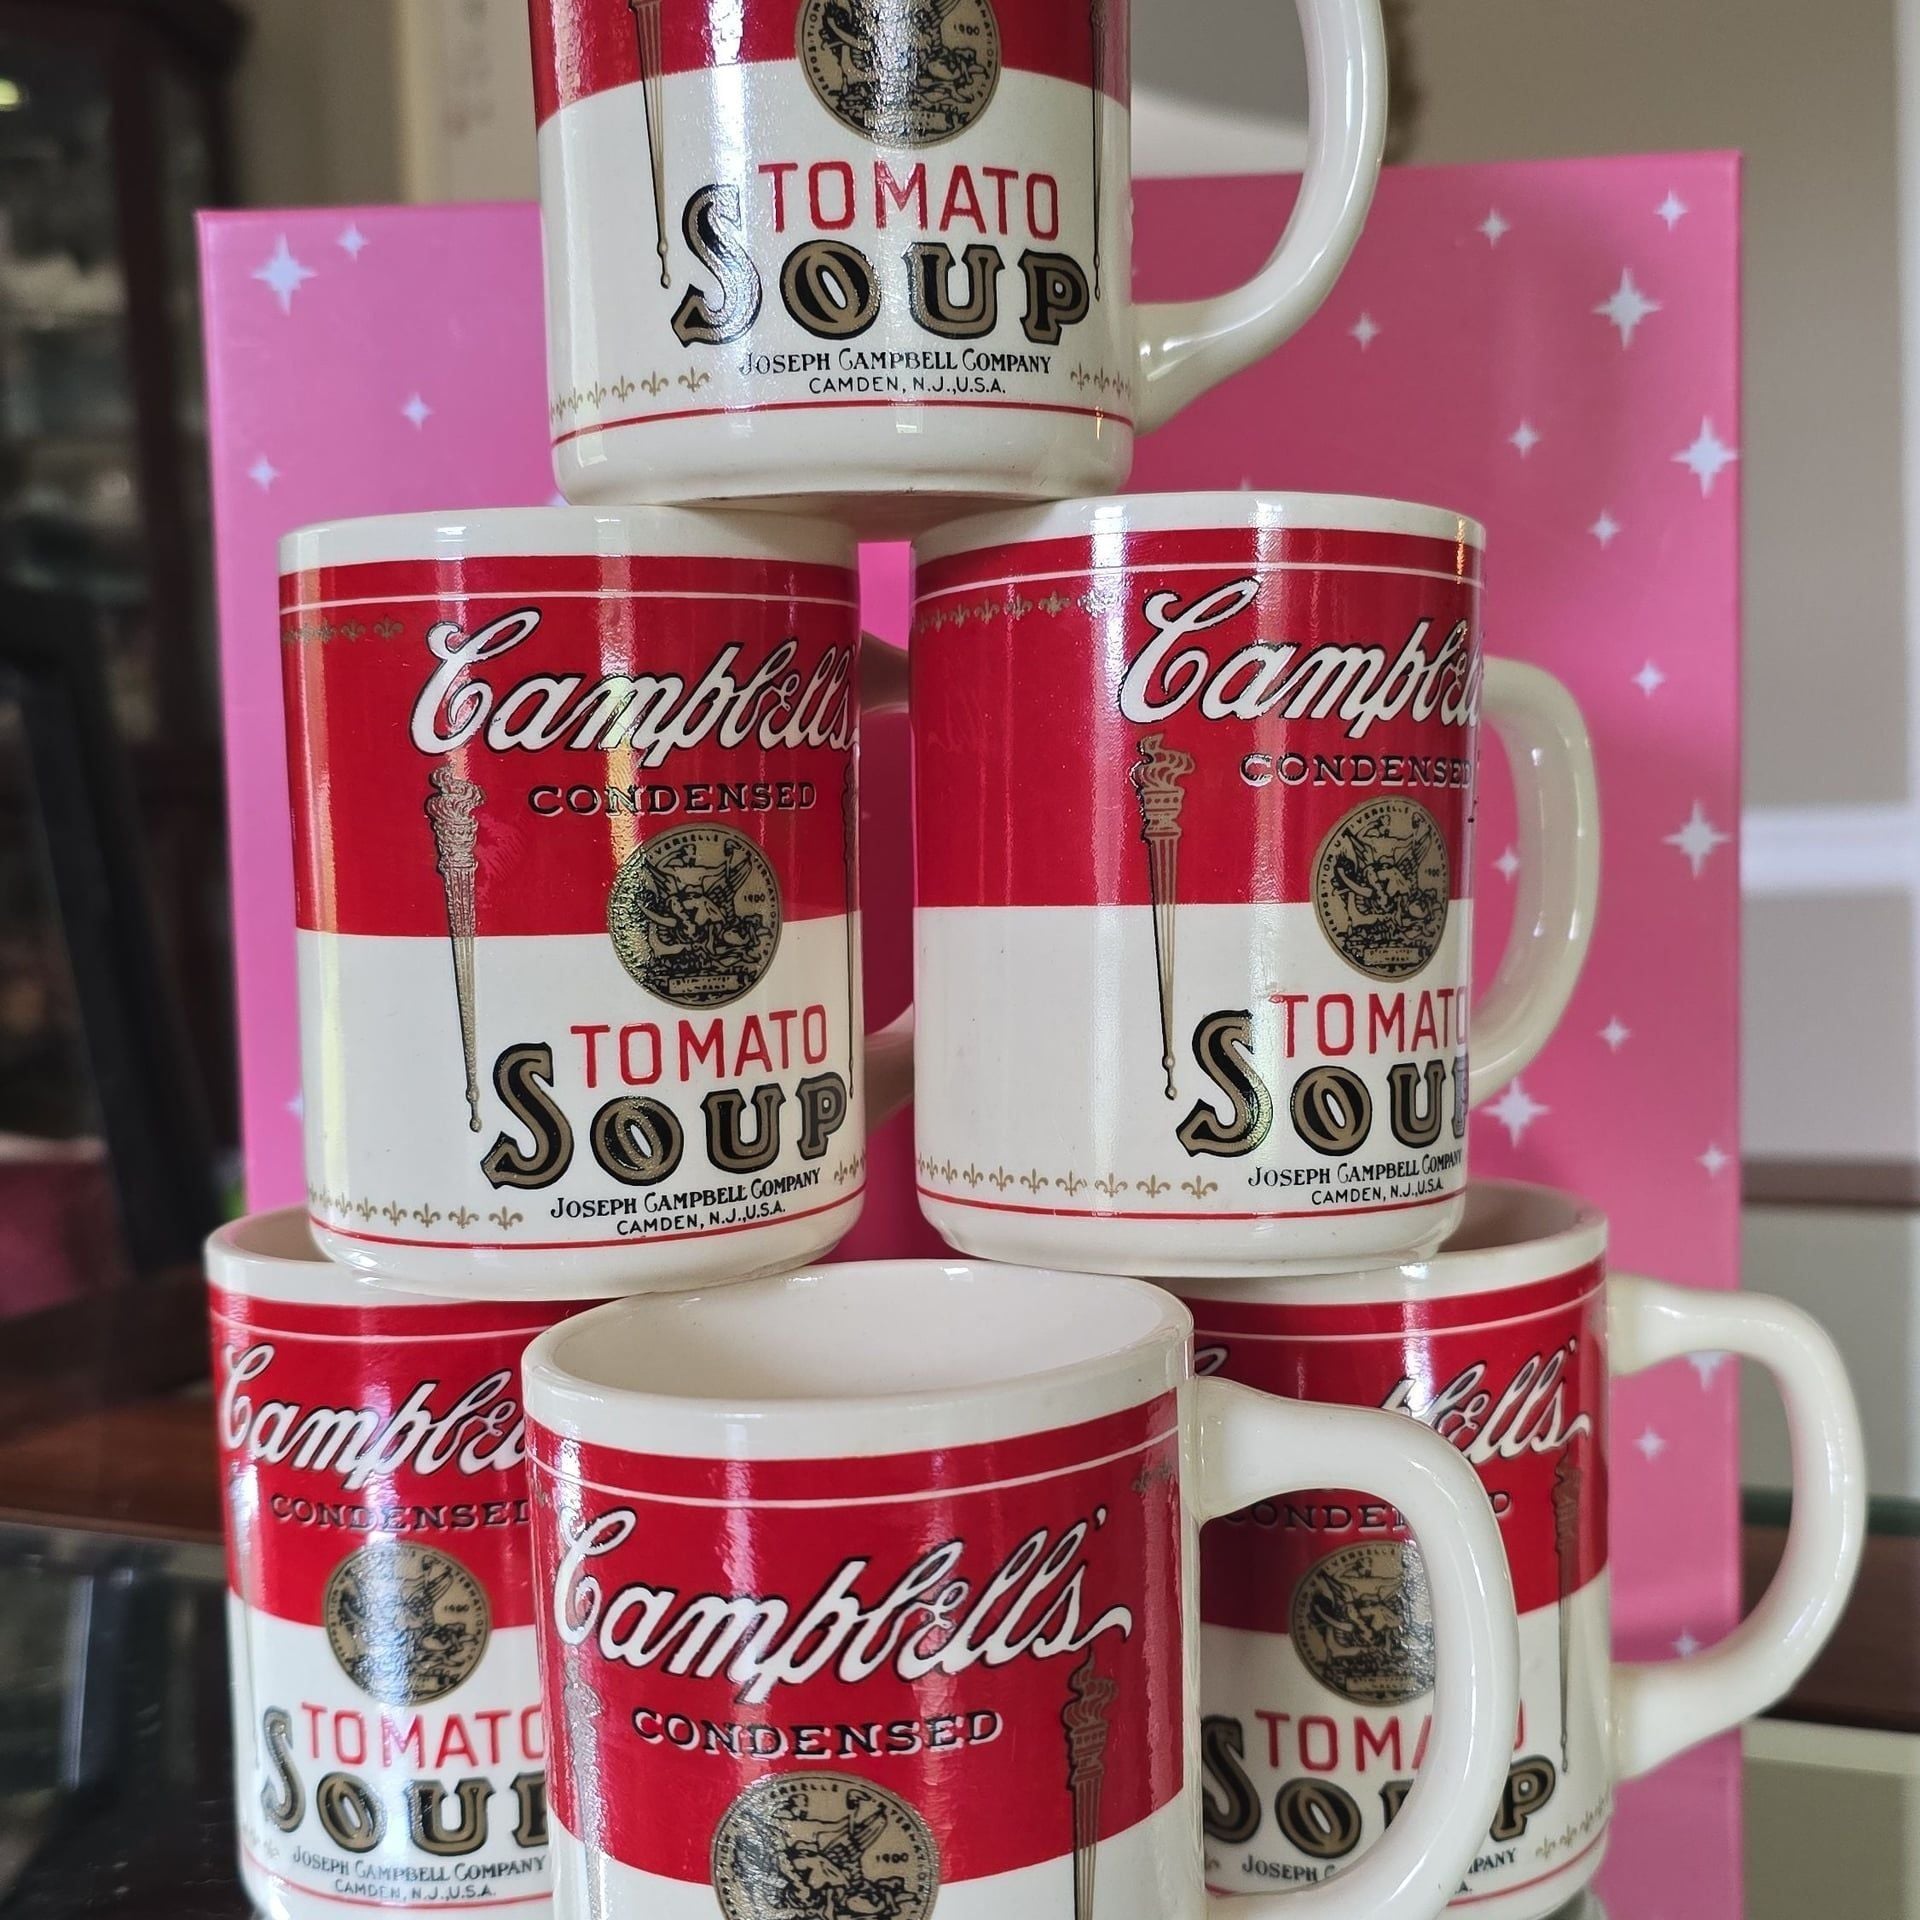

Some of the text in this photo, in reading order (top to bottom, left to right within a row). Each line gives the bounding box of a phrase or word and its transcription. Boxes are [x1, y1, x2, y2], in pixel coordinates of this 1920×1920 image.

[758, 161, 1059, 240] TOMATO
[671, 184, 1089, 346] SOUP
[739, 347, 1051, 376] JOSEPH CAMPBELL COMPANY
[809, 376, 907, 395] CAMDEN,
[1240, 752, 1472, 788] CONDENSED
[529, 781, 817, 816] CONDENSED
[570, 1004, 829, 1089] TOMATO
[481, 1041, 846, 1189] SOUP
[1248, 1149, 1463, 1187] JOSEPH CAMPBELL COMPANY
[550, 1166, 821, 1219] JOSEPH CAMPBELL COMPANY
[1311, 1188, 1387, 1205] CAMDEN,
[616, 1216, 704, 1236] CAMDEN,
[554, 1506, 1133, 1705] Campbell's
[631, 1709, 1003, 1760] CONDENSED
[1201, 1714, 1555, 1859] SOP
[293, 1846, 547, 1882] JOSEPH CAMPBELL COMPANY
[1242, 1854, 1318, 1883] JOSEPH
